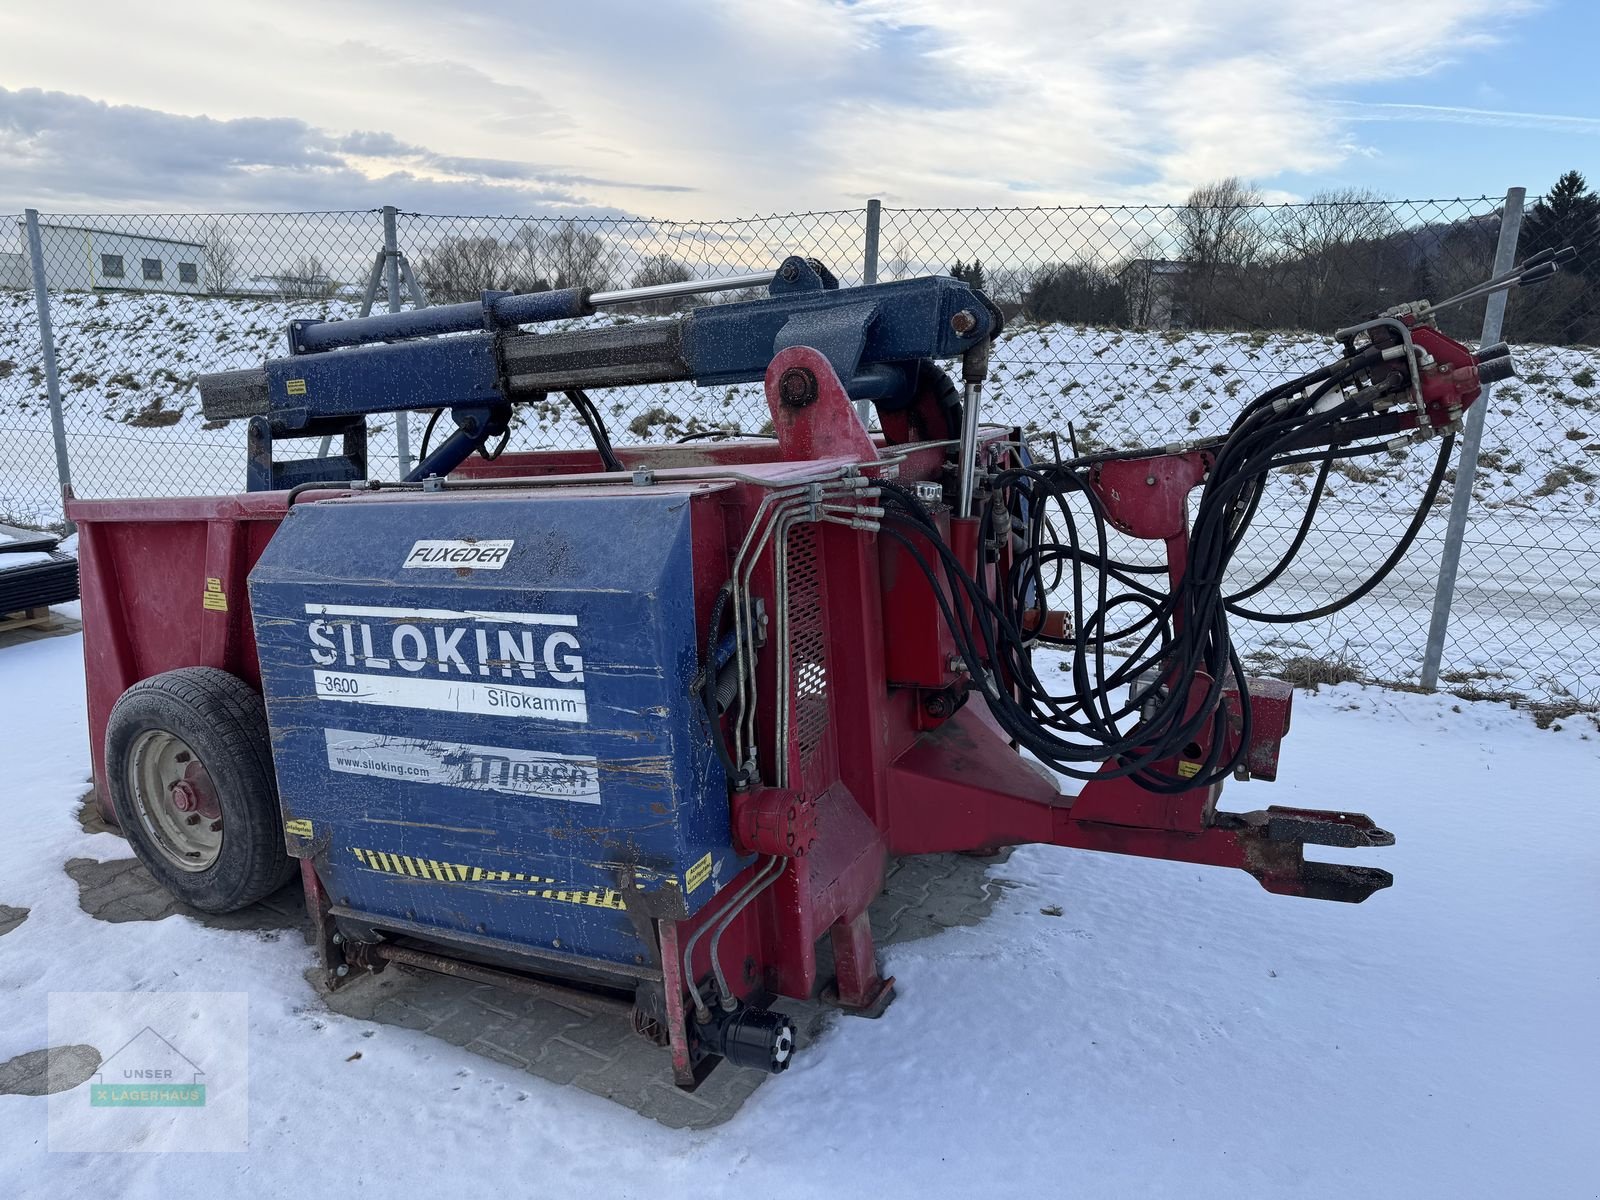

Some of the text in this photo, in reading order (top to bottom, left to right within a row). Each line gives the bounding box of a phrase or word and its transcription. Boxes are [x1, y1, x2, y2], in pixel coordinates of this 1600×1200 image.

[408, 547, 509, 563] FLIXEDER
[308, 619, 585, 683] SILOKING
[324, 676, 577, 713] 3600 Silokamm
[336, 757, 430, 777] www.siloking.com
